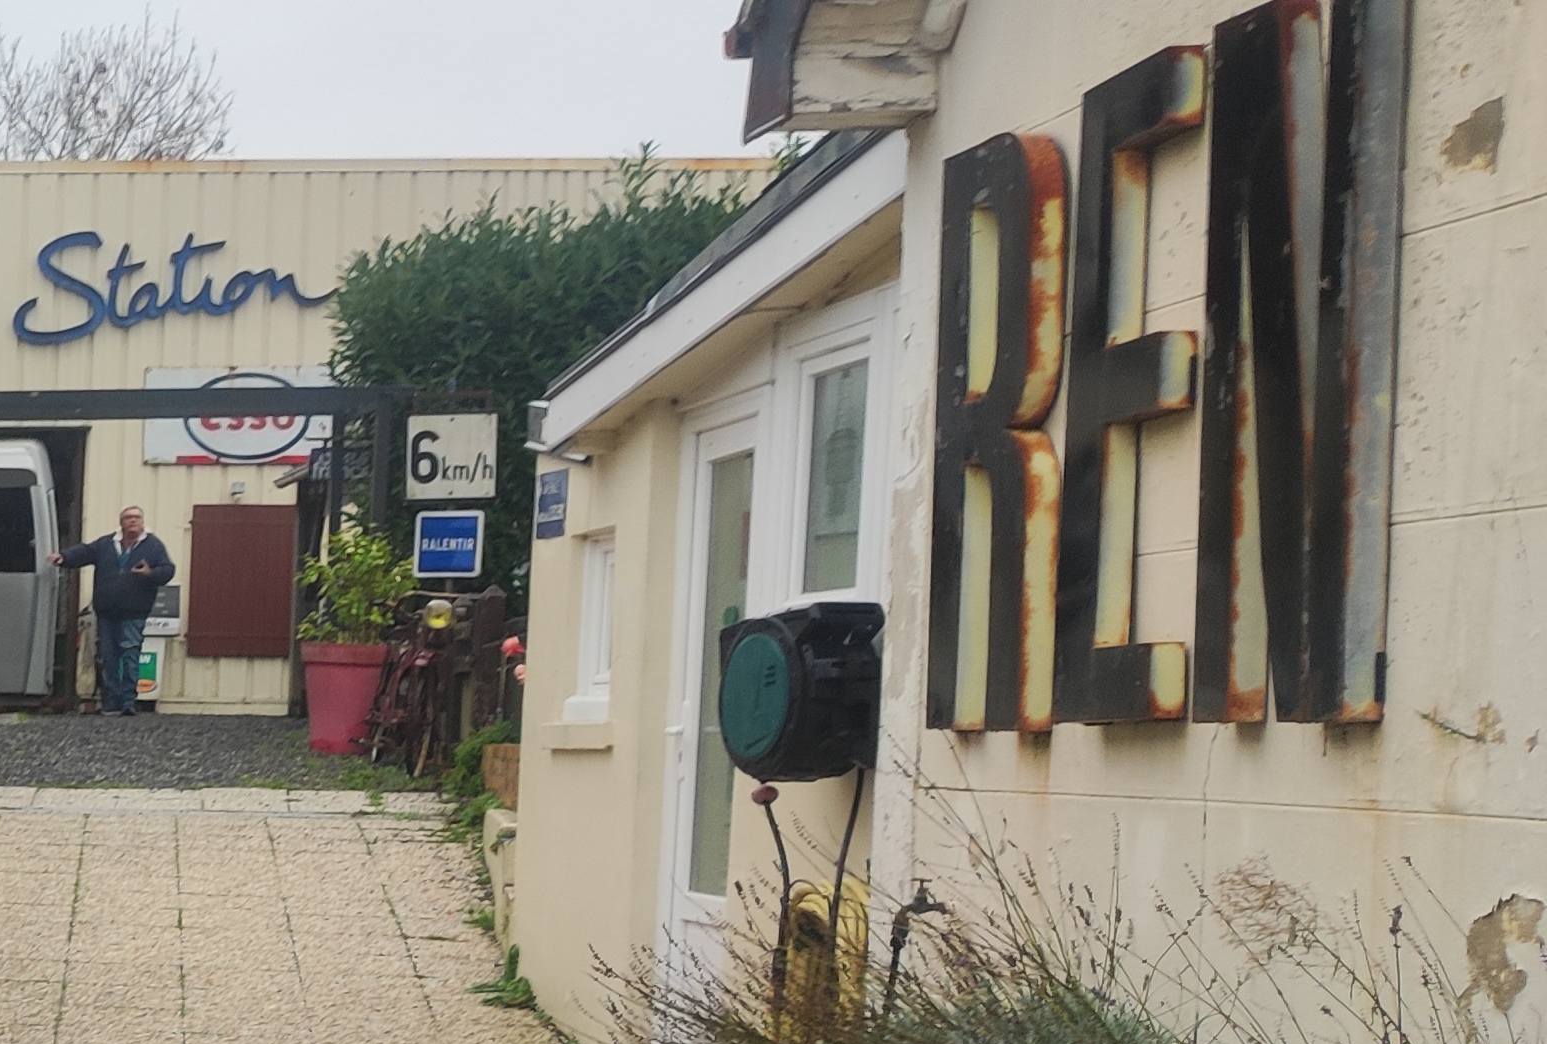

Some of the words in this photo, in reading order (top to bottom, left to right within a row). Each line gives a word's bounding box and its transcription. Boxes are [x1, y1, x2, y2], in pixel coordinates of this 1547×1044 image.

[13, 231, 338, 346] Station
[927, 0, 1406, 731] REN
[411, 430, 439, 484] 6
[442, 452, 494, 484] km/h
[422, 537, 475, 551] RALENTIR
